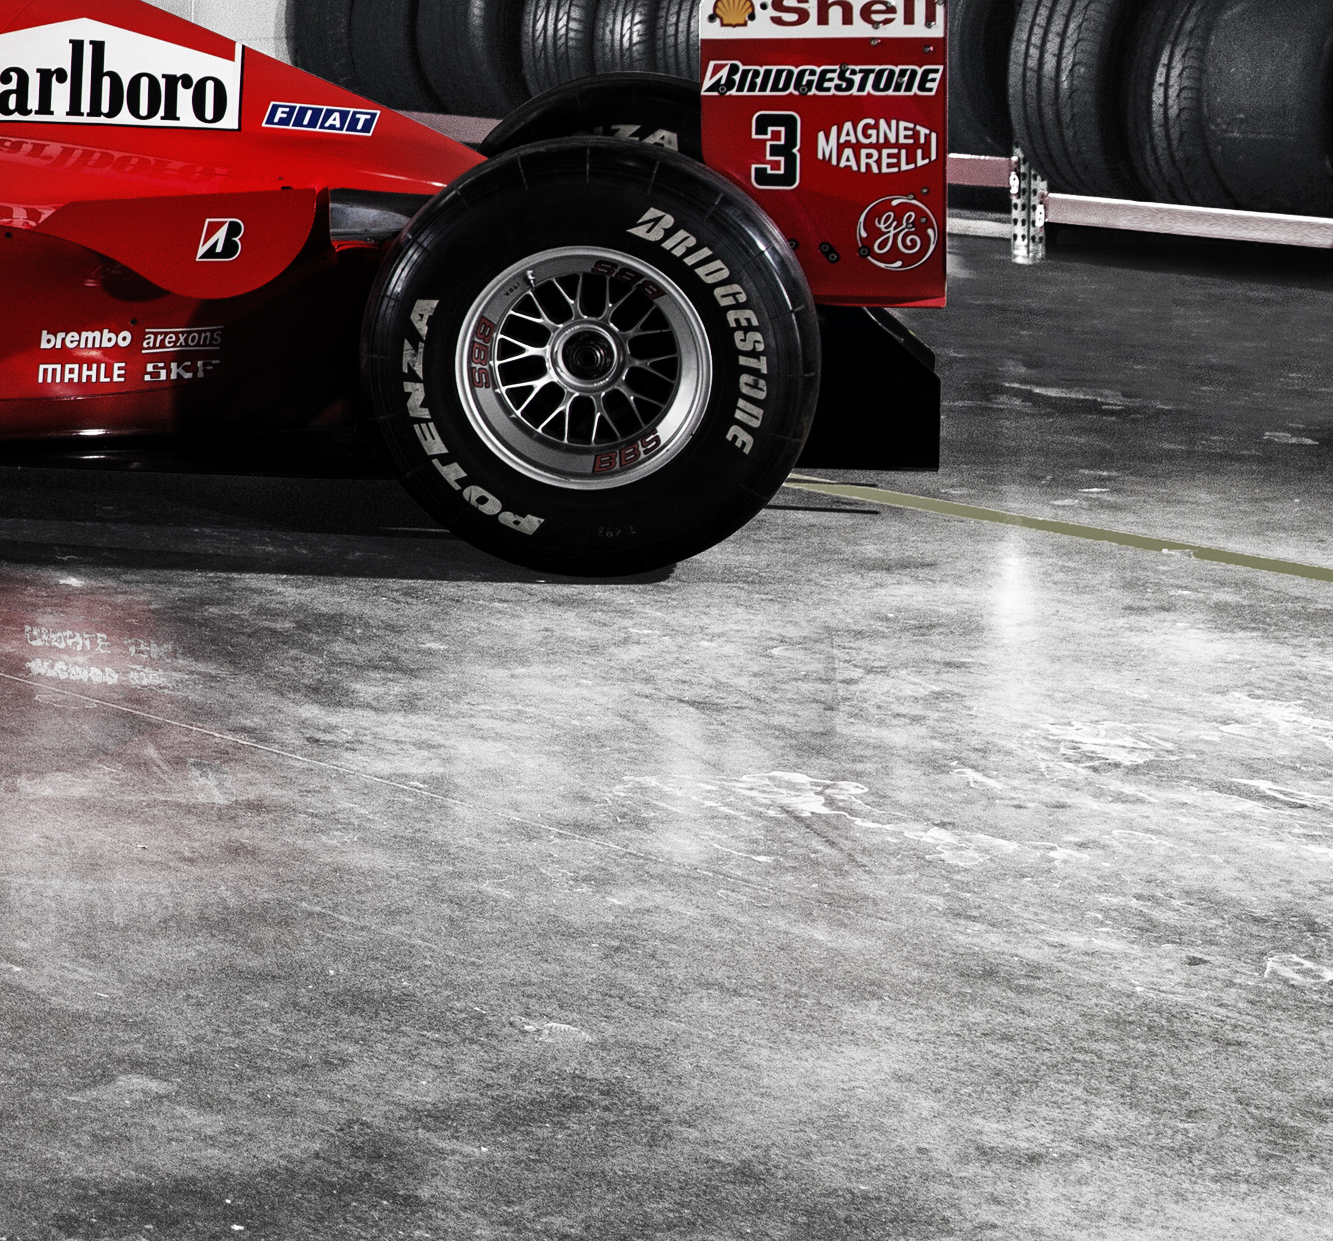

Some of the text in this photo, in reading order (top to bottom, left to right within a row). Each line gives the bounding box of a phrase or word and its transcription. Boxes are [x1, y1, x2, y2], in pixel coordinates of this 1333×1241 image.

[701, 60, 944, 96] BRIDGESTONE
[273, 107, 372, 131] FIAT
[817, 118, 937, 154] MAGNETI
[751, 110, 801, 190] 3
[40, 329, 222, 349] brembo arexons
[626, 207, 768, 455] BRIDGESTONE
[38, 360, 220, 384] MAHLE SKF
[469, 315, 496, 389] BBS
[402, 299, 545, 536] POTENZA
[592, 428, 661, 473] BBS
